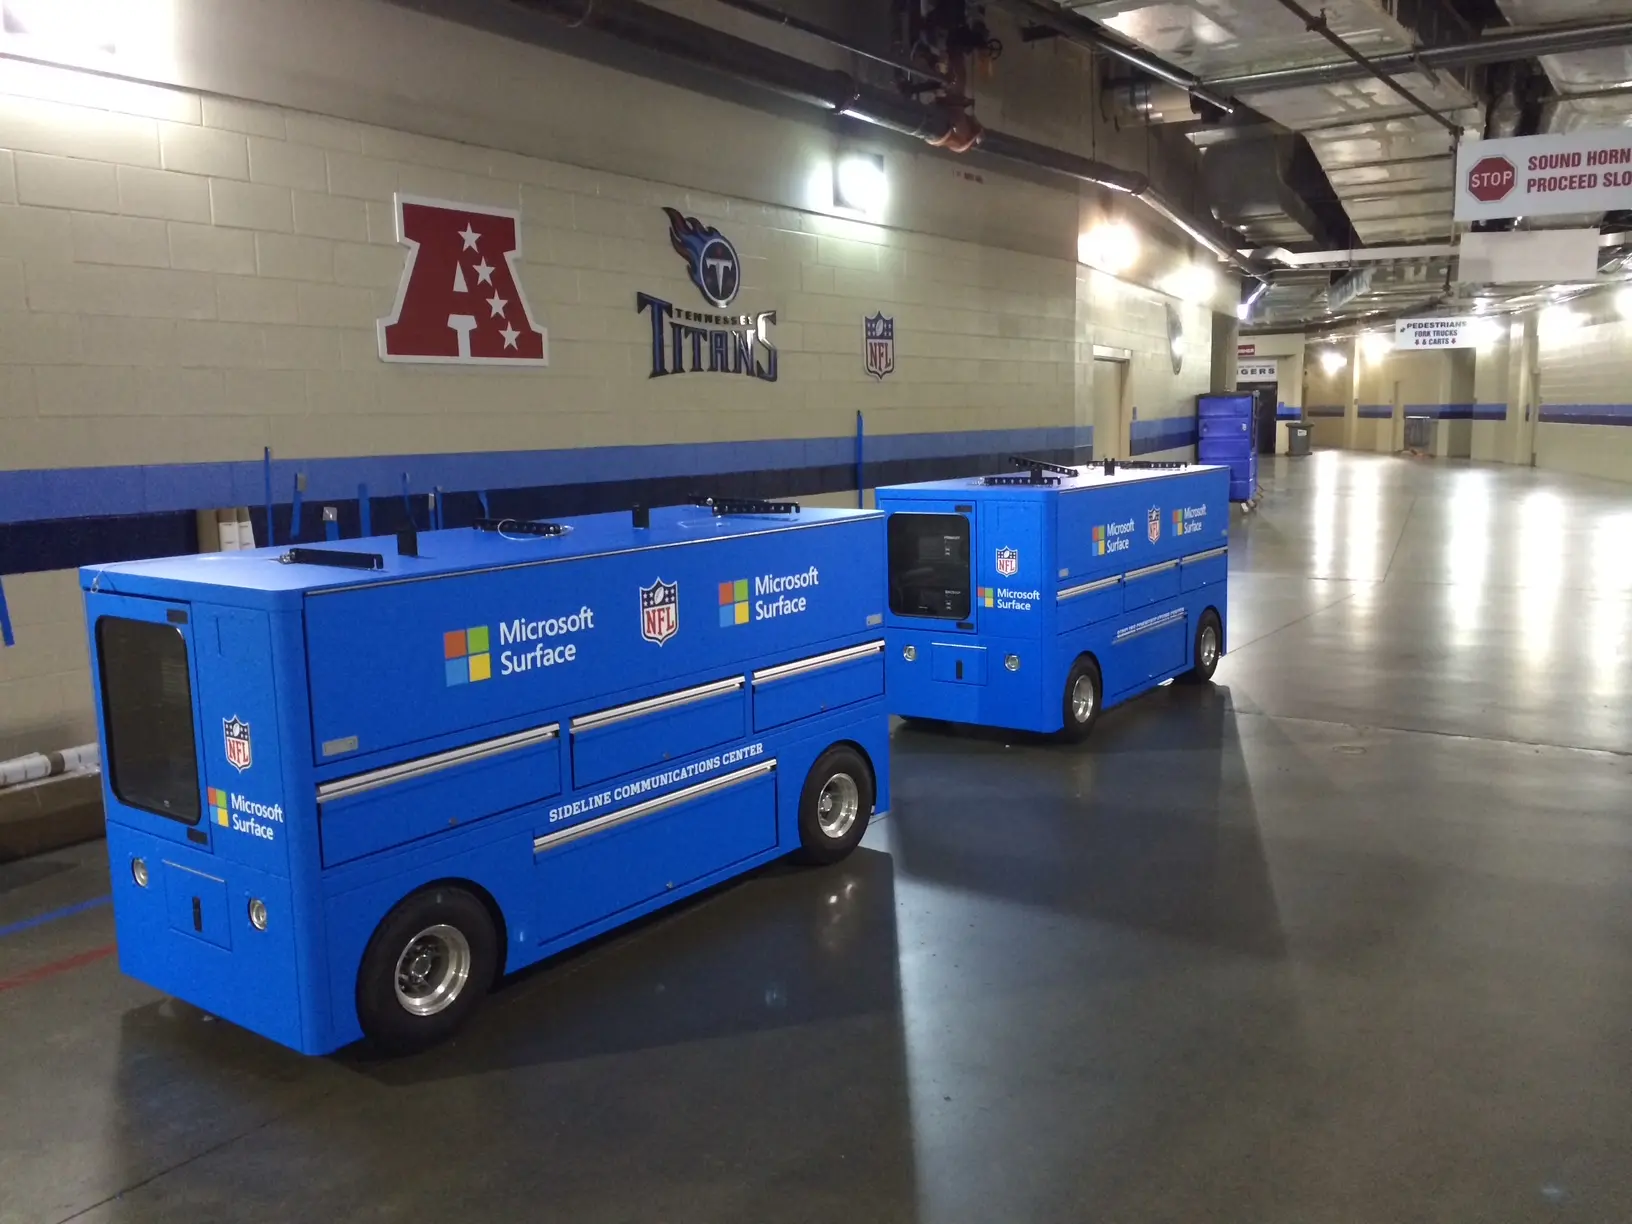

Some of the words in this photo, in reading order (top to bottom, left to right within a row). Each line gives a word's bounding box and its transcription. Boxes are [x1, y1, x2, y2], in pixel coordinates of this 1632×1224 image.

[1528, 152, 1581, 171] SOUND
[1587, 148, 1632, 166] HORN
[1471, 170, 1513, 188] STOP
[1527, 173, 1597, 193] PROCEED
[674, 307, 753, 326] TENNESSEE
[1406, 321, 1468, 329] PEDESTRIANS
[637, 292, 778, 382] TITANS
[1414, 330, 1431, 338] FORK
[1433, 329, 1458, 337] TRUCKS
[869, 341, 892, 370] NFL
[1184, 503, 1207, 520] Microsoft
[1107, 518, 1135, 537] Microsoft
[1184, 520, 1202, 535] Surface
[1107, 538, 1129, 553] Surface
[999, 559, 1015, 572] NFL
[754, 566, 819, 596] Microsoft
[997, 588, 1040, 600] Microsoft
[755, 596, 807, 621] Surface
[997, 599, 1031, 611] Surface
[499, 606, 594, 646] Microsoft
[644, 605, 675, 637] NFL
[500, 643, 576, 675] Surface
[227, 738, 249, 764] NFL
[549, 791, 612, 822] SIDELINE
[614, 756, 720, 801] COMMUNICATIONS
[722, 742, 763, 766] CENTER
[230, 793, 284, 823] Microsoft
[232, 814, 274, 840] Surface
